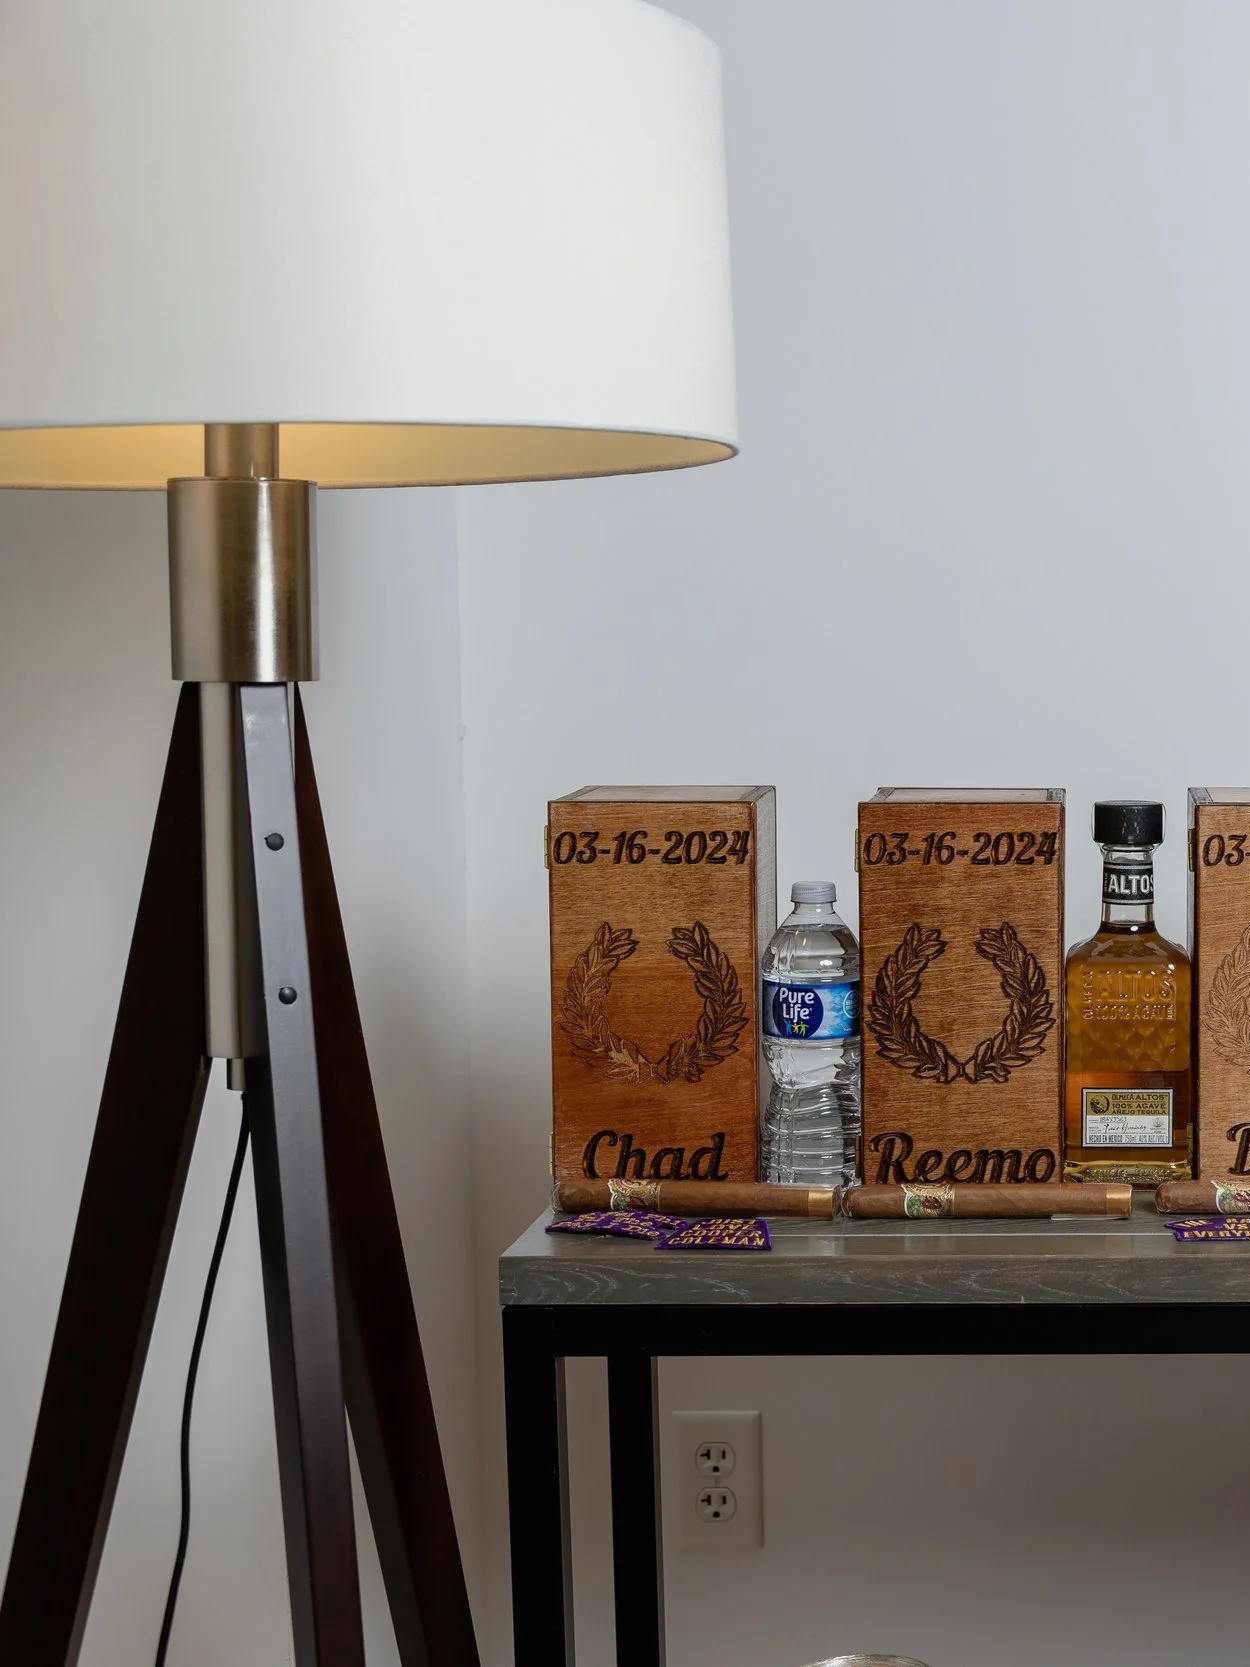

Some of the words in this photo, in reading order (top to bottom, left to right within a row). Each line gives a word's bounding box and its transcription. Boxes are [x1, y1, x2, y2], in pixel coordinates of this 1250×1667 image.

[553, 831, 750, 865] 03-16-2024
[862, 831, 1057, 865] 03-16-2024
[780, 987, 815, 1004] Pure
[783, 1003, 810, 1023] Life
[582, 1129, 729, 1181] Chad
[869, 1132, 1056, 1184] Reemo
[668, 1237, 765, 1246] COLEMAN
[680, 1230, 761, 1238] COOPER
